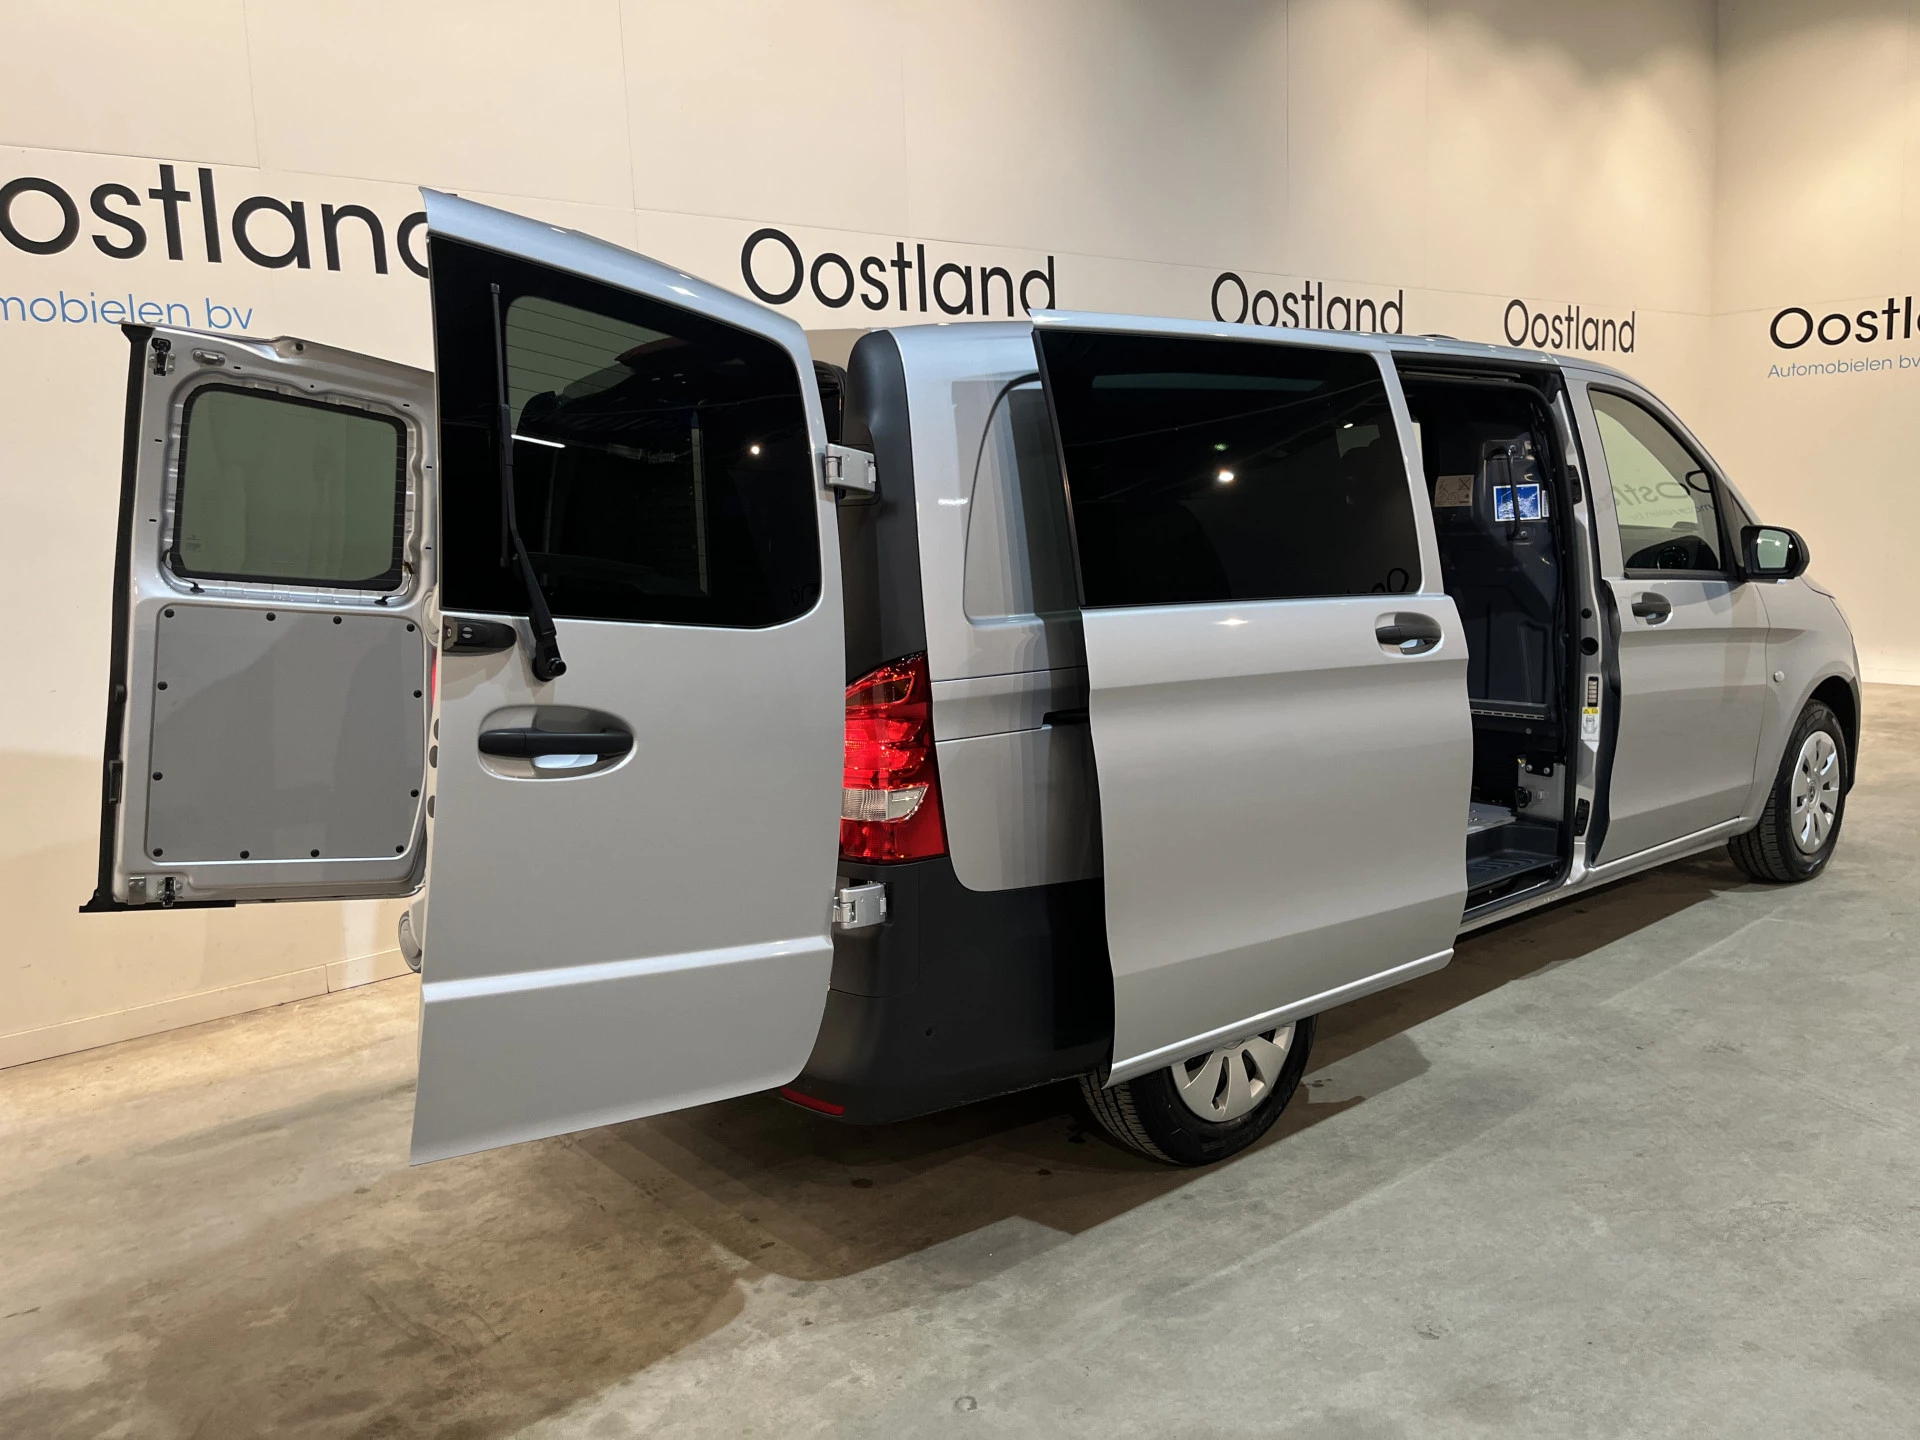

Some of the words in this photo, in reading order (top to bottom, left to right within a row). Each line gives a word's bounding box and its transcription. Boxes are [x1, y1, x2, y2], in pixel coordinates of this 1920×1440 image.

[741, 228, 1056, 317] Oostland
[205, 298, 253, 330] bv
[1211, 272, 1403, 335] Oostland
[1504, 299, 1635, 353] Oostland
[1769, 296, 1920, 349] Oostl
[1767, 357, 1893, 379] Automobielen
[1899, 354, 1920, 369] bv
